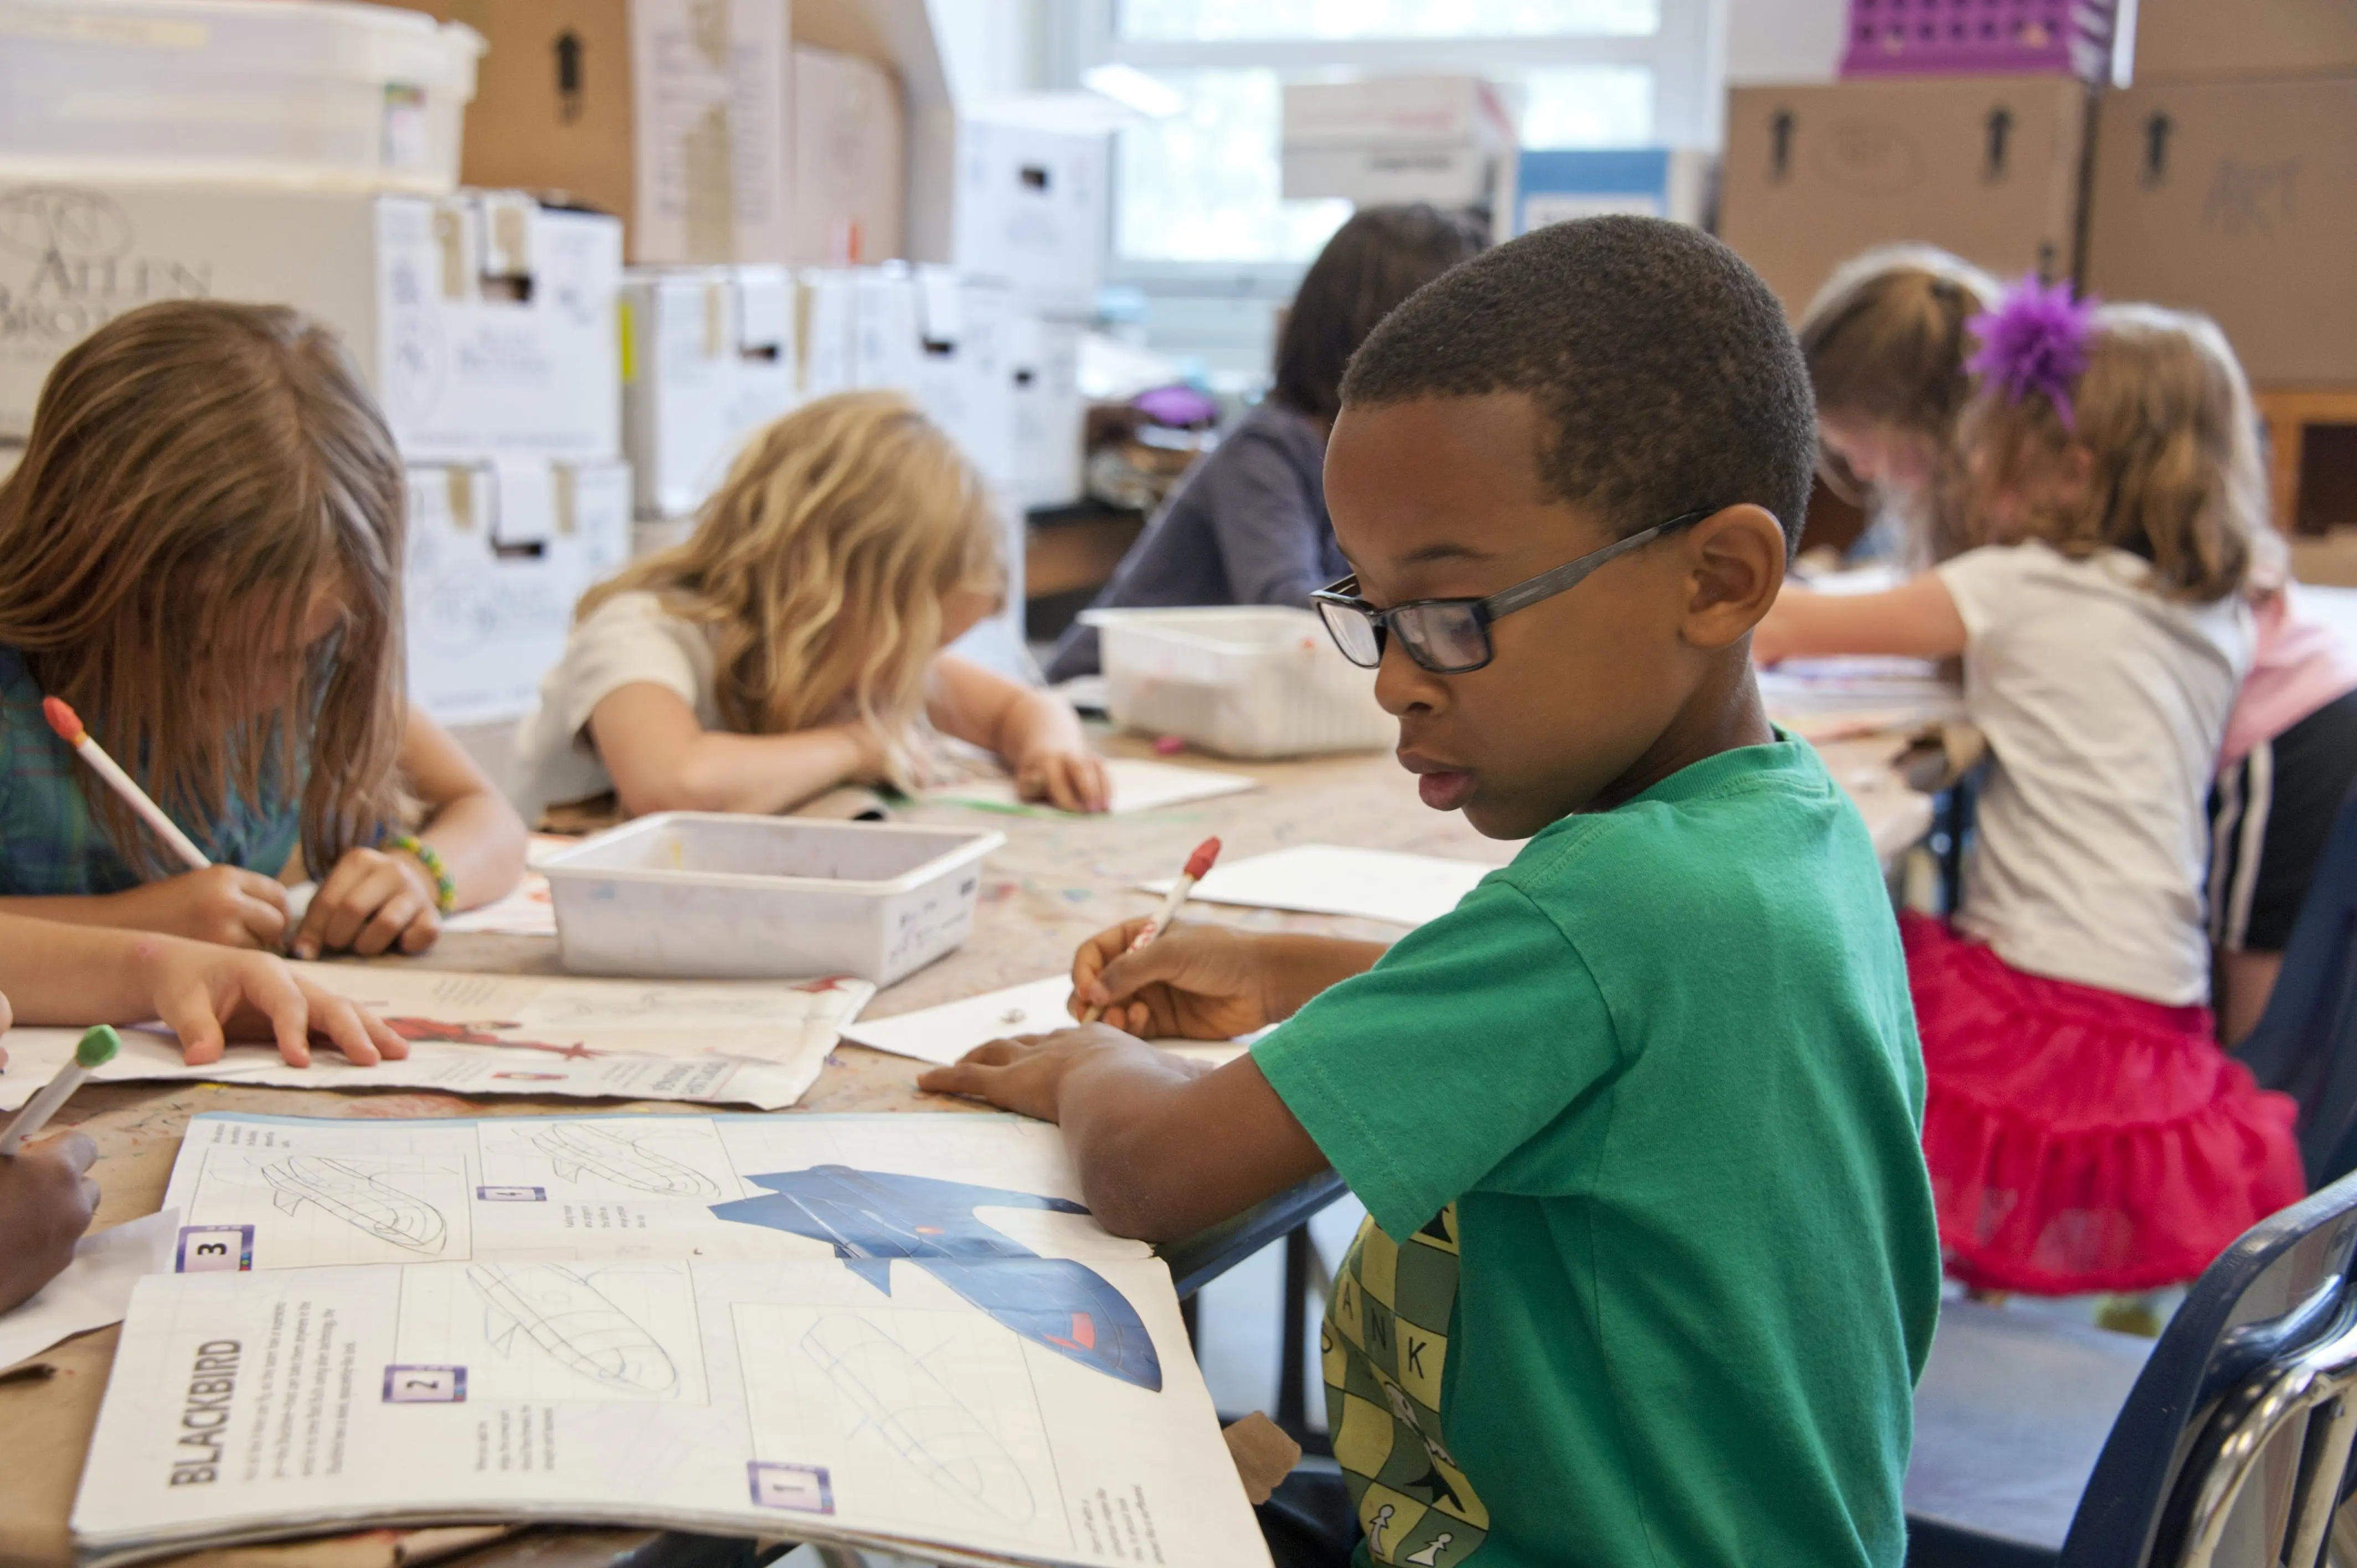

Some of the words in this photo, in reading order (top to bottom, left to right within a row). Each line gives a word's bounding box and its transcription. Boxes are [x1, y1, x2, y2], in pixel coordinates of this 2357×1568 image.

[196, 1242, 228, 1256] 3
[405, 1380, 439, 1389] 2
[169, 1339, 243, 1488] BLACKBIRD
[773, 1483, 805, 1493] 1
